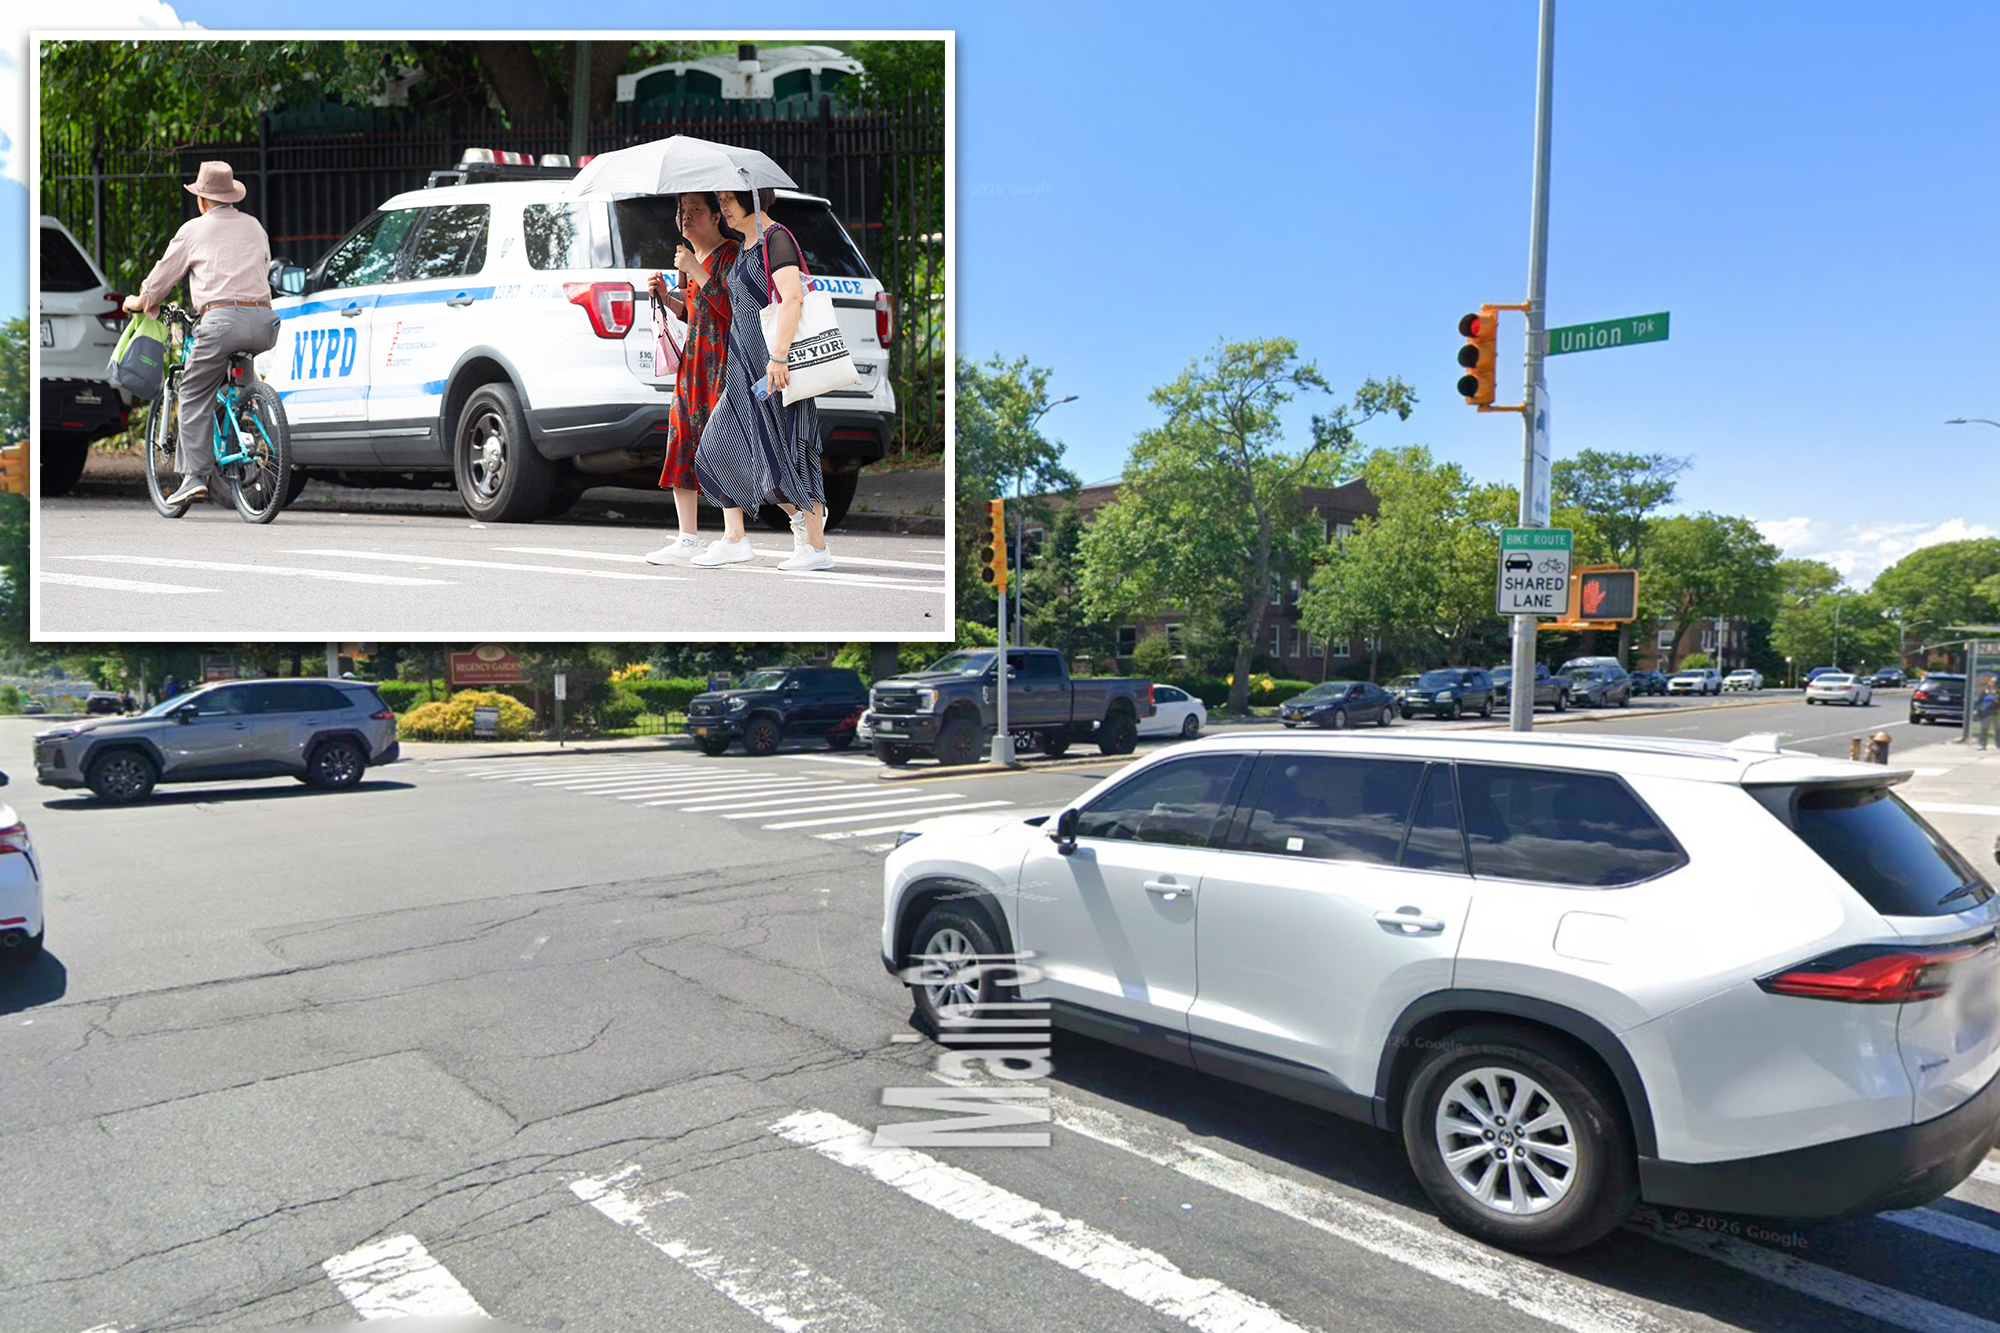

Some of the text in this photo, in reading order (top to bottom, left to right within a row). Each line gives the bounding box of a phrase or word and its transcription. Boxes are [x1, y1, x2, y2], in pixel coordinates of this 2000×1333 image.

[813, 278, 864, 296] OLICE
[1560, 318, 1655, 352] Union Tpk
[290, 327, 358, 381] NYPD
[788, 348, 807, 363] EW
[1506, 534, 1567, 546] BIKE ROUTE
[1504, 577, 1565, 591] SHARED
[1513, 594, 1553, 608] LANE
[456, 662, 525, 672] REGENCY GARDEN
